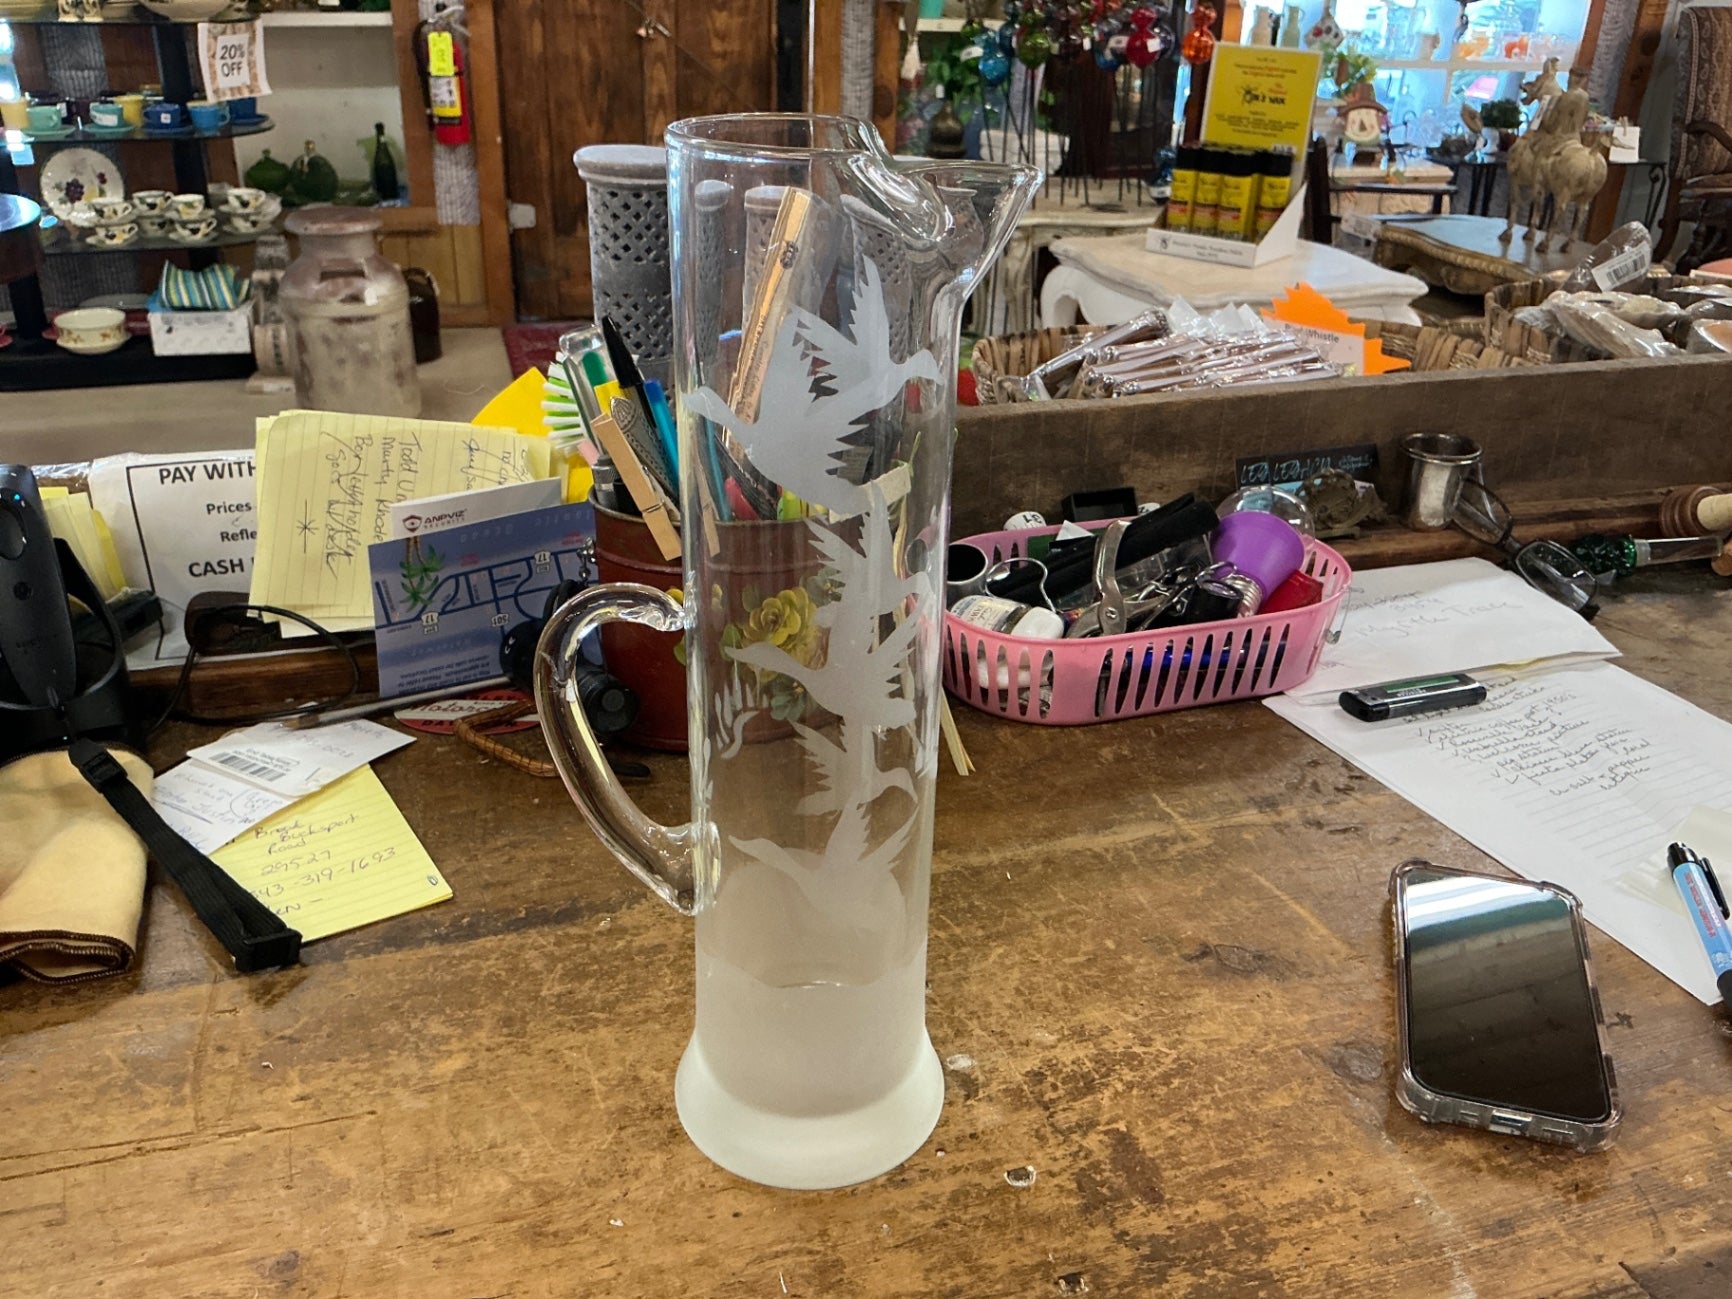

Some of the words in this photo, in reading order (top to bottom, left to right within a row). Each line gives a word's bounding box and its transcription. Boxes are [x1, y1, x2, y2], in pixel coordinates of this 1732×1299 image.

[220, 44, 245, 60] 20%
[221, 62, 242, 77] OFF
[1305, 329, 1340, 343] Whistle
[398, 432, 422, 474] Todd
[159, 465, 196, 485] PAY
[206, 501, 252, 515] Prices
[424, 510, 465, 524] ANPVIZ
[538, 552, 548, 562] 17
[188, 558, 244, 578] CASH
[494, 614, 508, 625] 501
[261, 850, 332, 877] 29527
